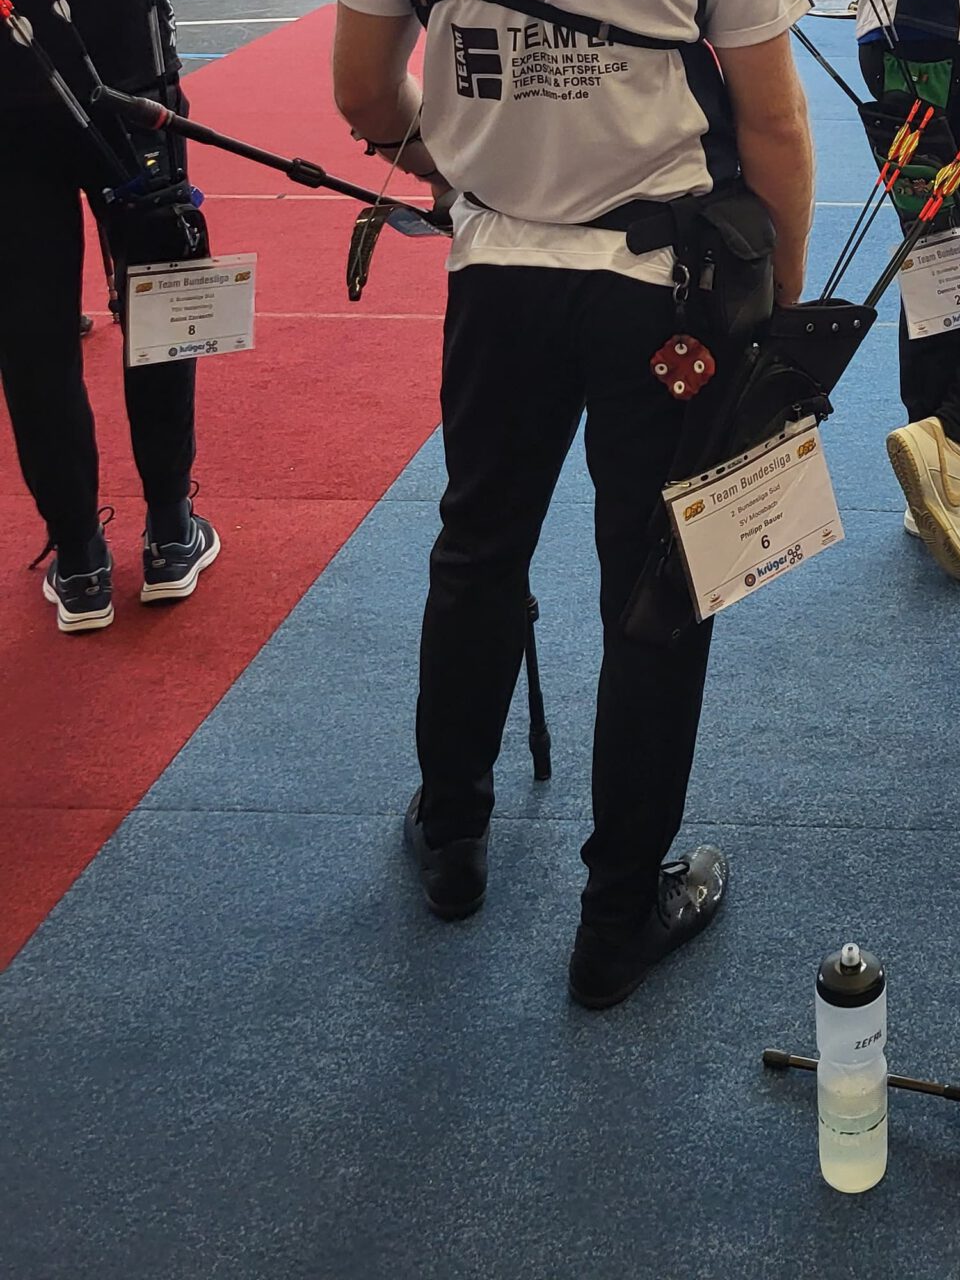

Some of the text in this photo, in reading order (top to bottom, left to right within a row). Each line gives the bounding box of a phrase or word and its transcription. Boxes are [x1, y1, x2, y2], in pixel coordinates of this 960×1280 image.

[455, 30, 470, 90] TEAM
[562, 53, 574, 64] IN
[577, 53, 600, 64] DER
[512, 74, 602, 89] TIEFBA & FORST
[916, 252, 937, 265] Team
[158, 275, 229, 290] Team Bundesliga
[188, 324, 196, 336] 8
[709, 452, 792, 506] Team Bundesliga
[739, 511, 784, 542] Philipp Bauer
[761, 534, 771, 550] 6
[756, 554, 788, 577] krüger
